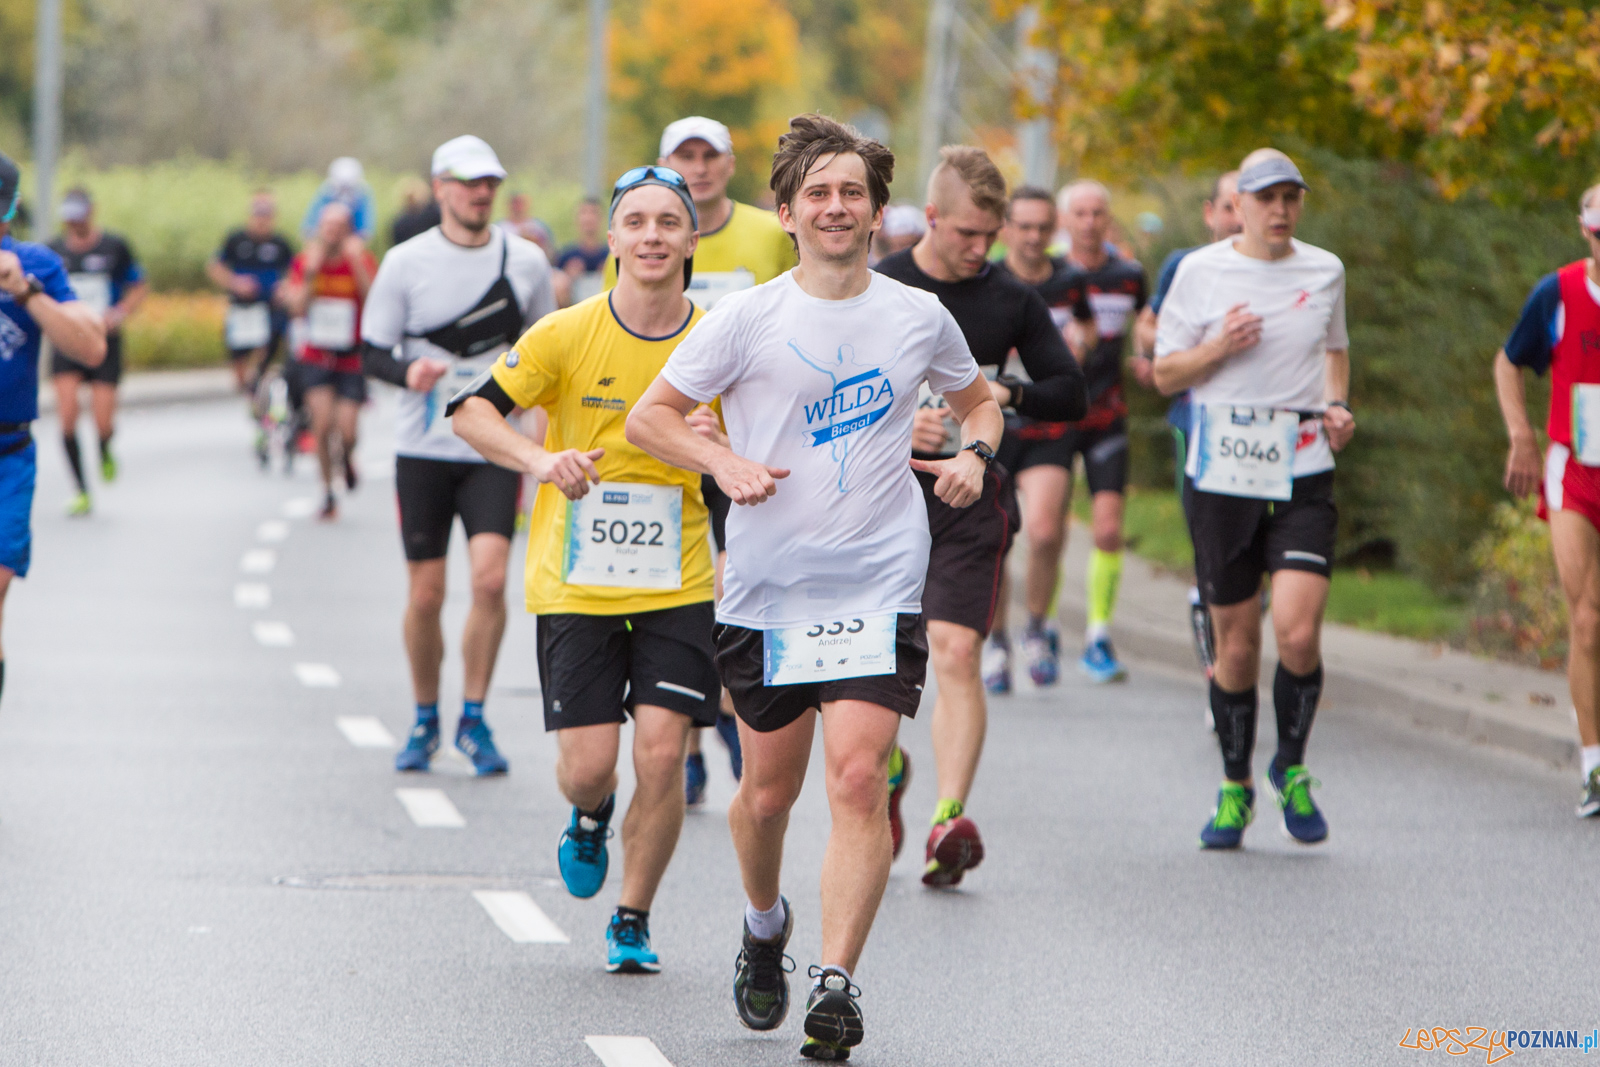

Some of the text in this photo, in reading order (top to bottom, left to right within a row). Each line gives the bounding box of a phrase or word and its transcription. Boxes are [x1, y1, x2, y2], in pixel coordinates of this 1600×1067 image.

[804, 378, 894, 425] WILDA
[1219, 435, 1280, 462] 5046
[591, 518, 664, 546] 5022
[818, 636, 852, 647] Andrzej
